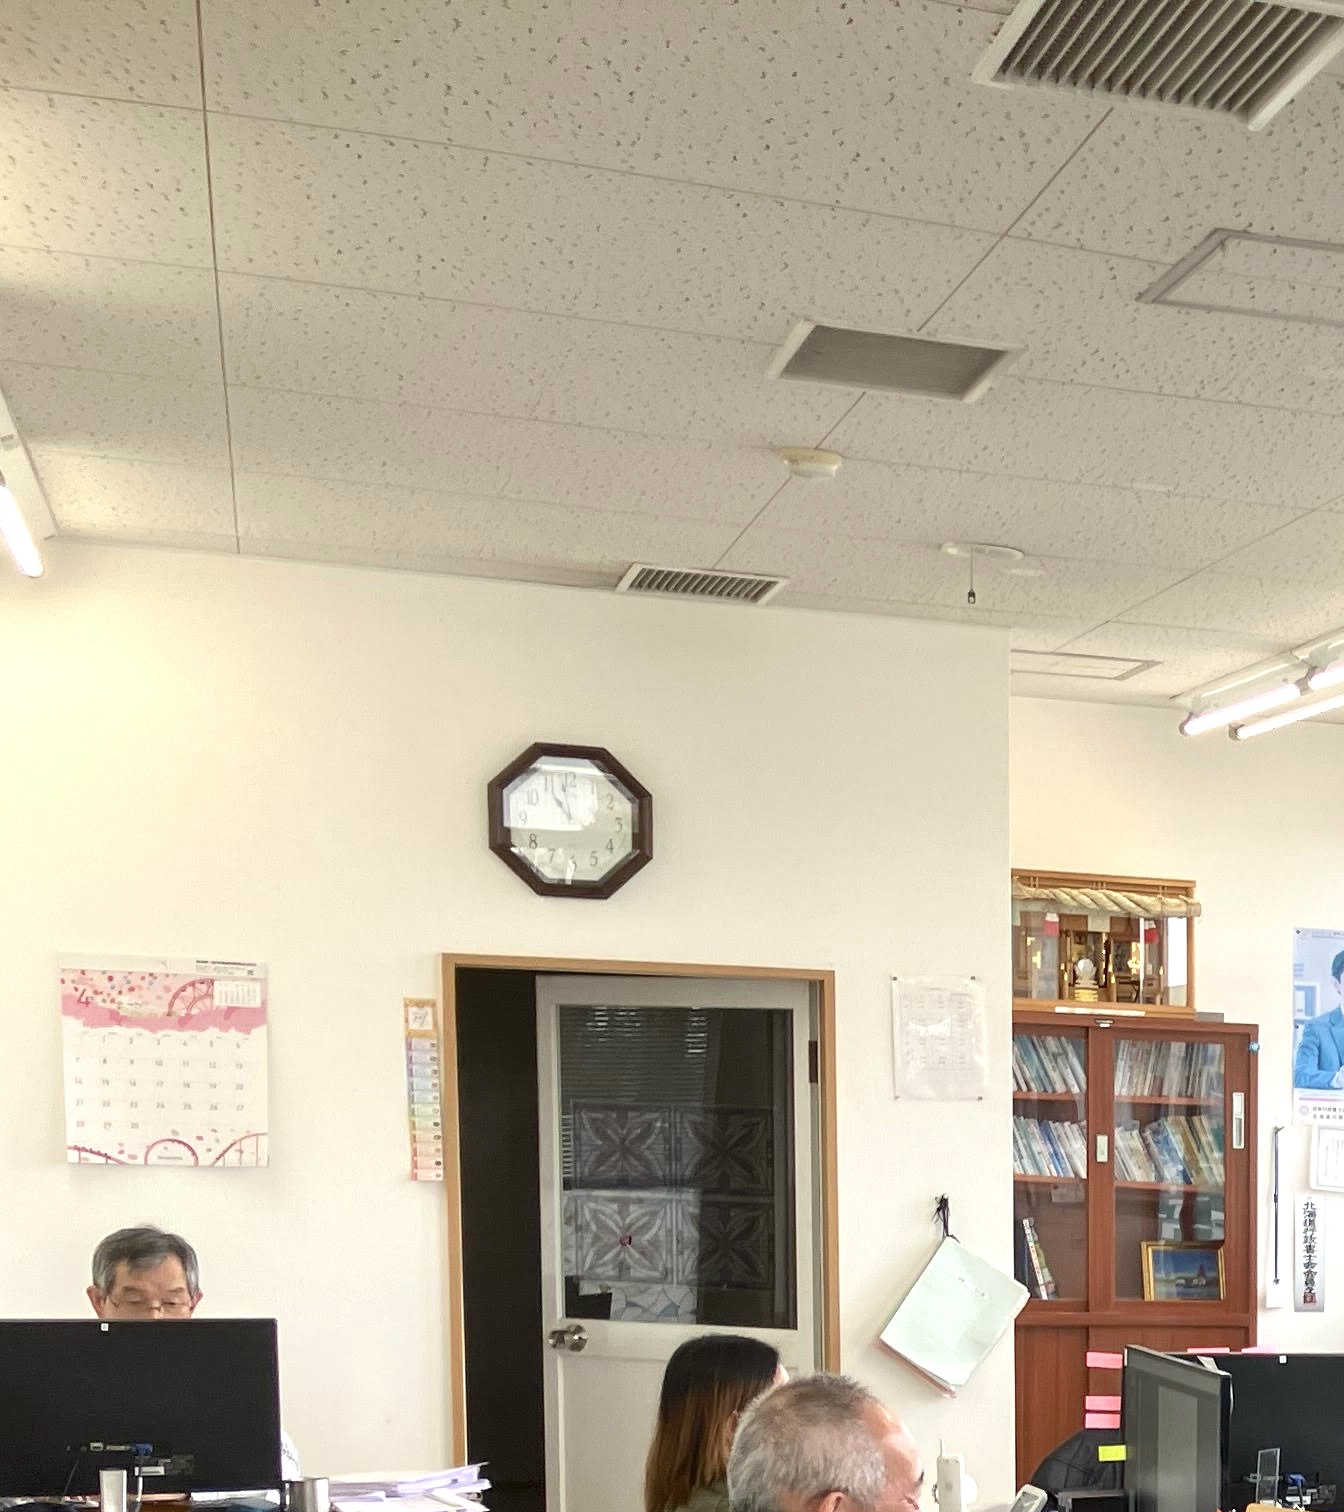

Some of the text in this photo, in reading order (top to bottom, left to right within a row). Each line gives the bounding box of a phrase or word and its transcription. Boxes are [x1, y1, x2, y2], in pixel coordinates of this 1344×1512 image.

[606, 793, 614, 810] 2
[615, 816, 622, 833] 3
[528, 833, 538, 850] 8
[605, 838, 614, 854] 4
[547, 848, 556, 864] 7
[589, 850, 598, 867] 5
